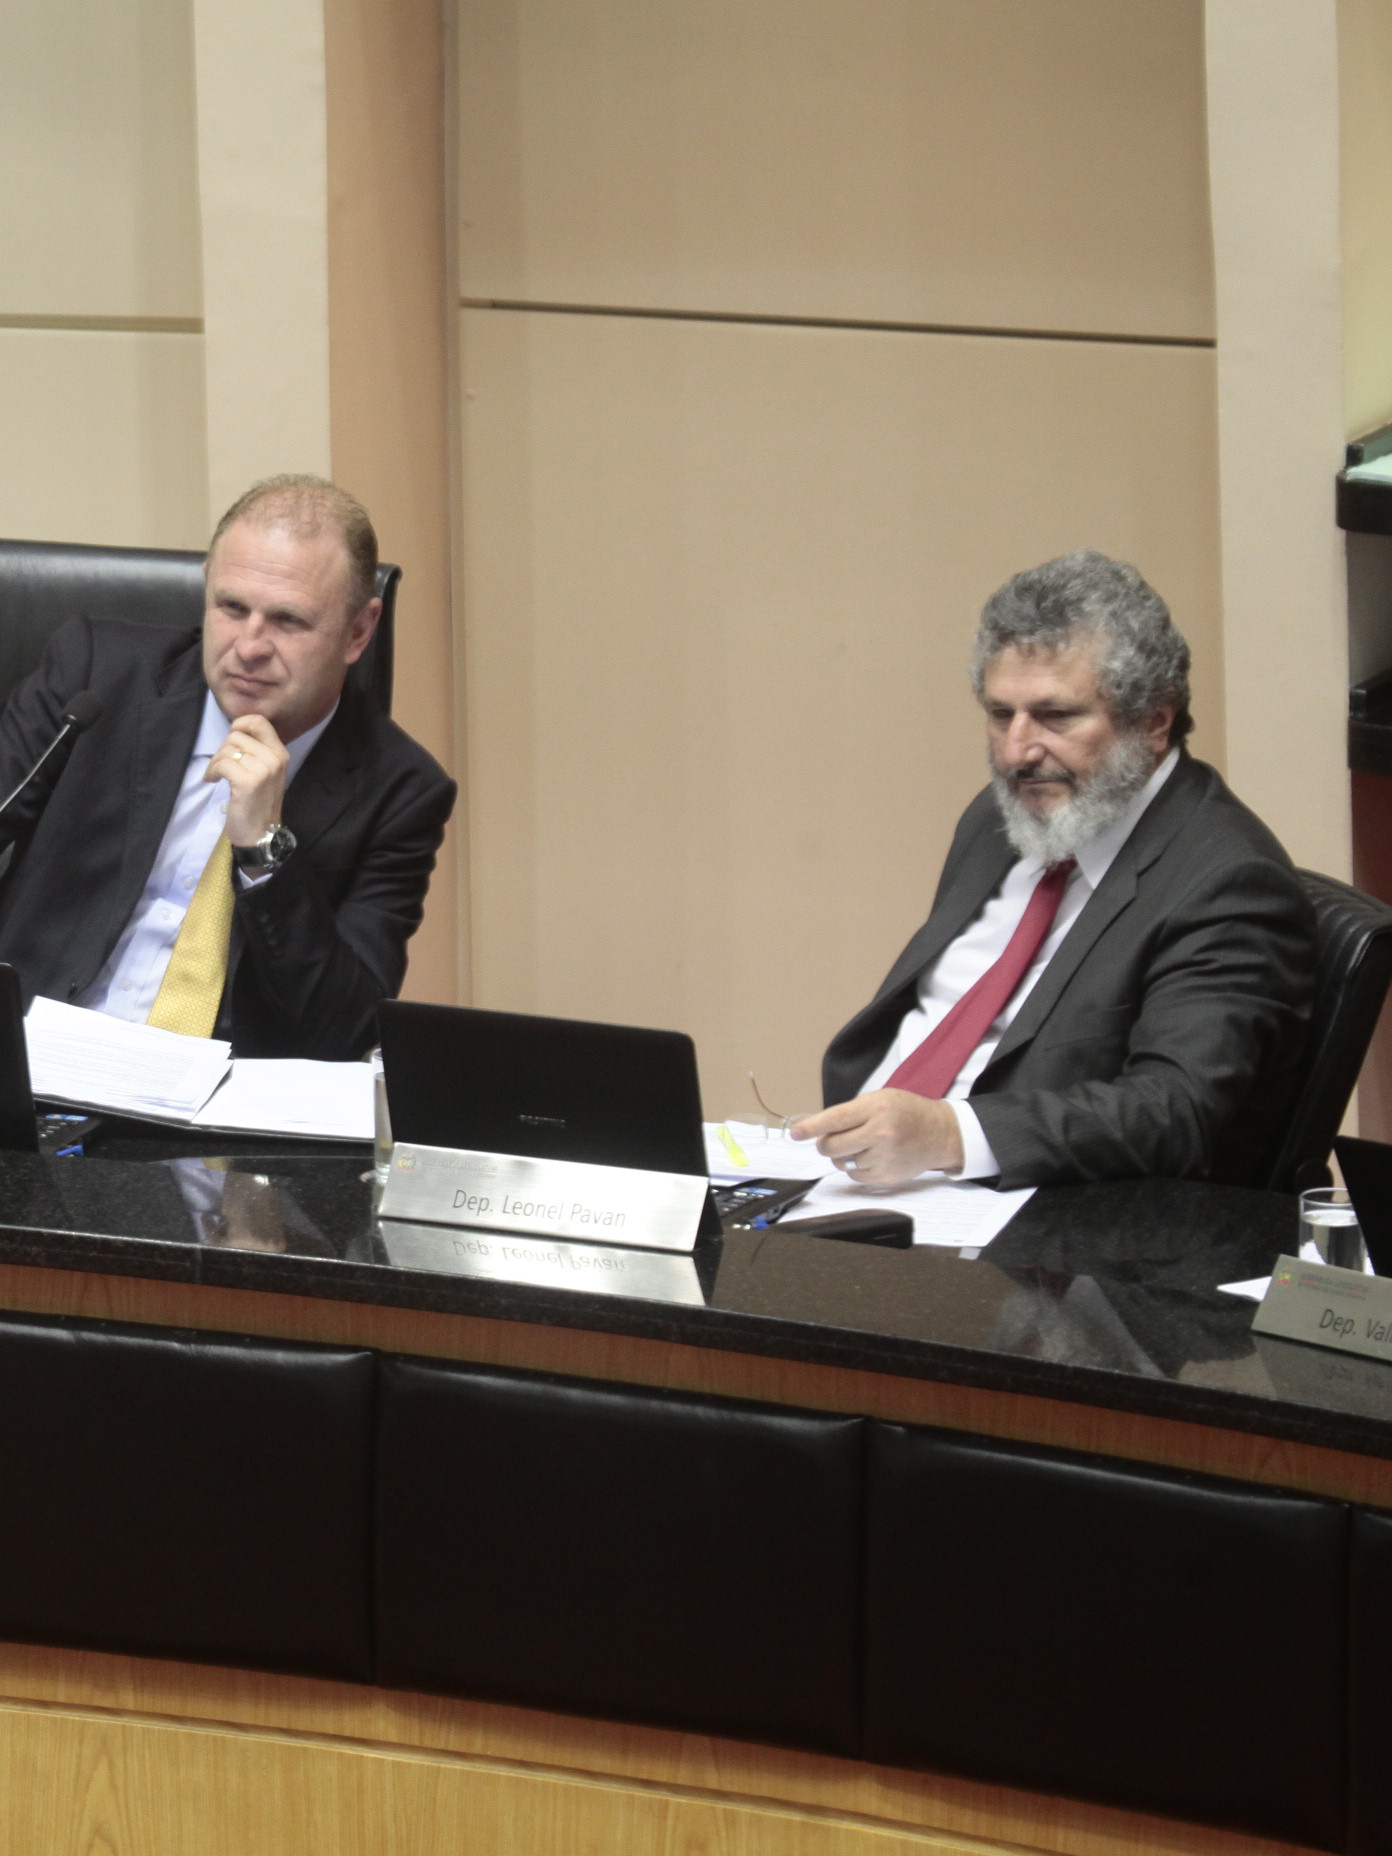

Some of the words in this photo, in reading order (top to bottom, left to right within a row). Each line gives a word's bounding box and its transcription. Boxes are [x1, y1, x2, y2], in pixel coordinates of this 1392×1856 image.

[452, 1189, 494, 1217] Dep.
[502, 1195, 565, 1221] Leonel
[569, 1203, 626, 1228] Pavan
[1319, 1308, 1357, 1338] Dep.
[1366, 1318, 1392, 1344] Val
